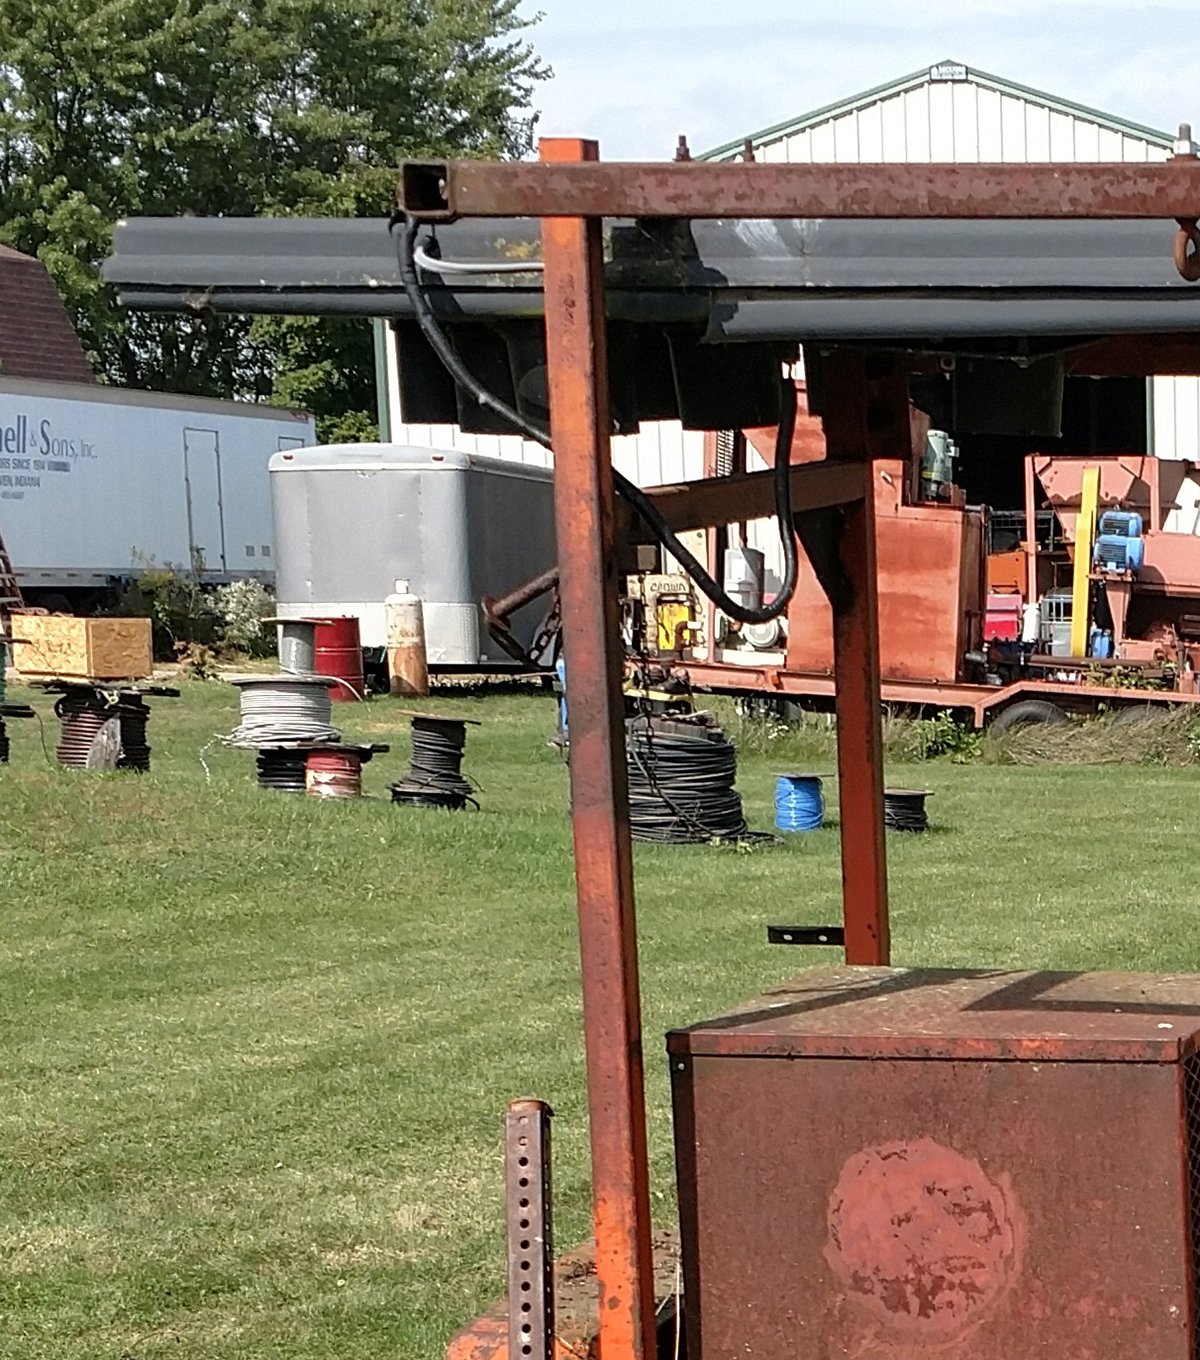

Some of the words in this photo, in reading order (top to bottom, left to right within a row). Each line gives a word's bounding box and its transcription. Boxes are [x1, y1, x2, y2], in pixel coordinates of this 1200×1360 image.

[0, 415, 27, 454] ell
[29, 430, 37, 447] &
[40, 419, 78, 463] Sons,
[80, 438, 98, 459] Inc.
[12, 458, 31, 470] SINCE
